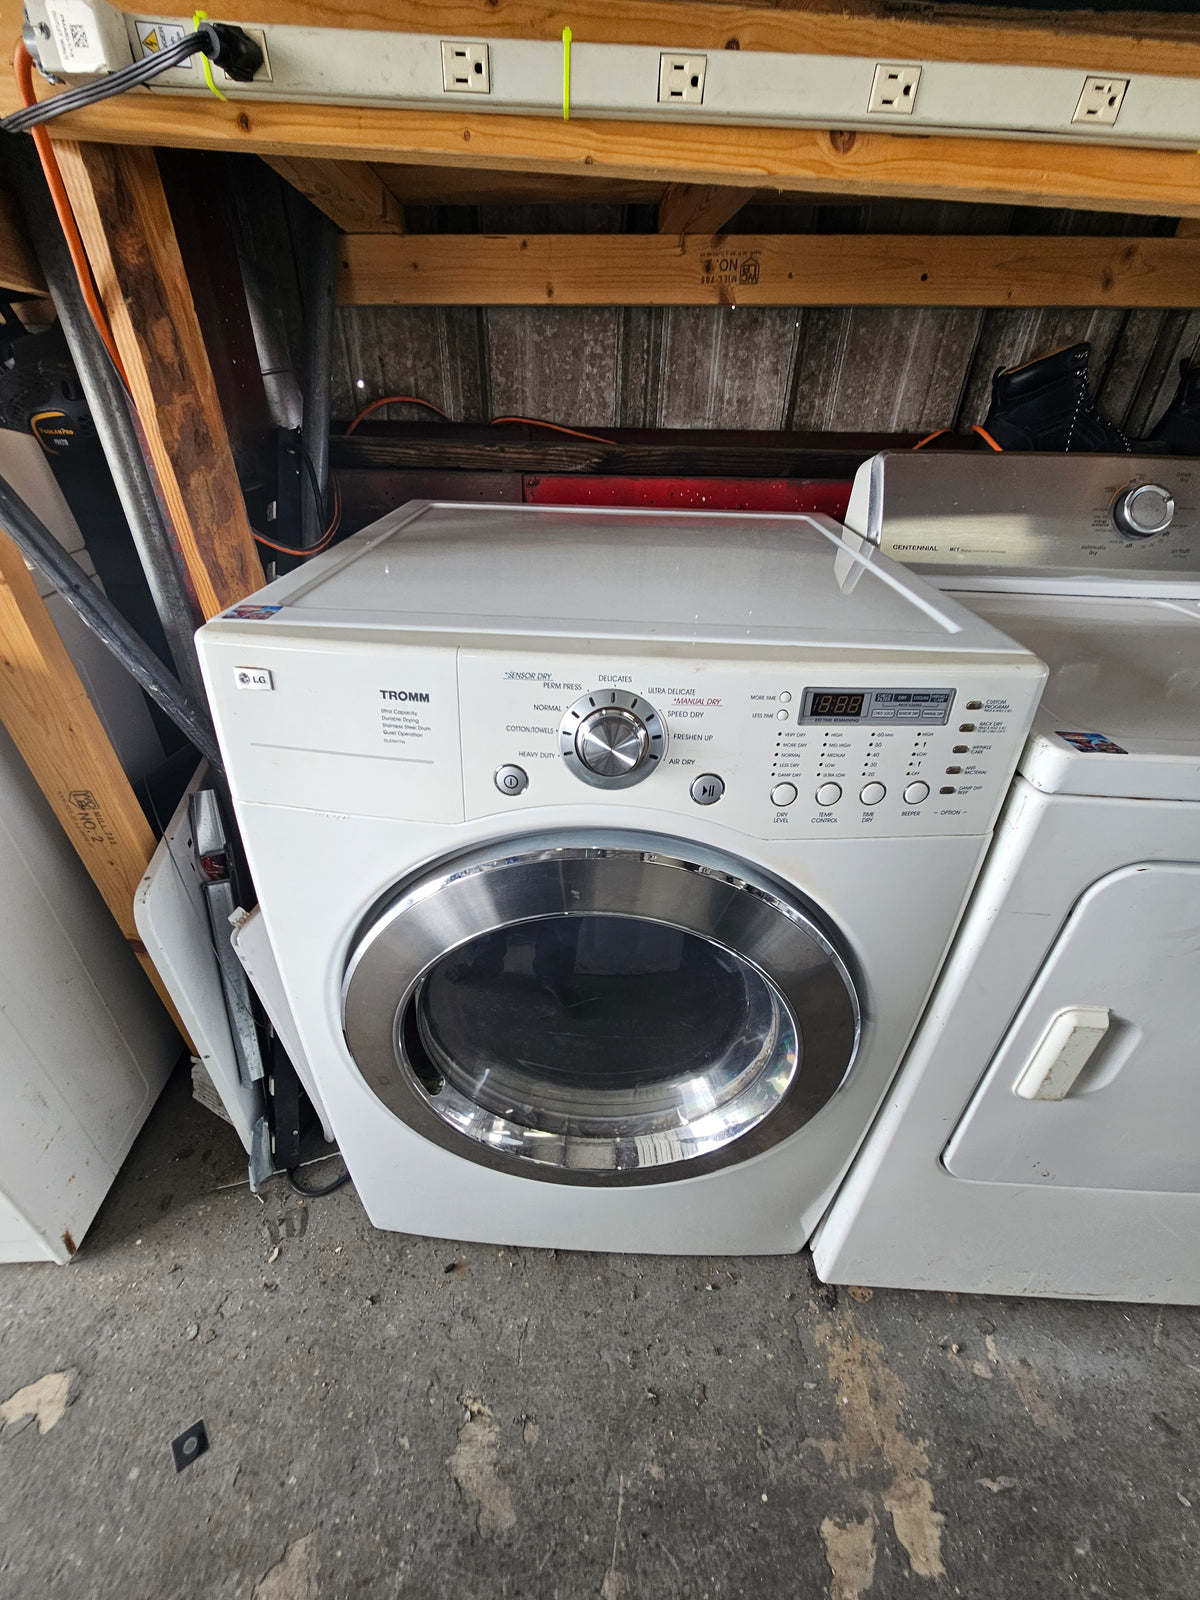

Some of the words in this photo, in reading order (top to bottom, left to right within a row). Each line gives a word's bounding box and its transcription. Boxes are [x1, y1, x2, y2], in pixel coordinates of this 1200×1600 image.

[380, 690, 430, 702] TROMM
[506, 725, 554, 734] COTTON/TOWELS
[77, 812, 97, 833] NO.
